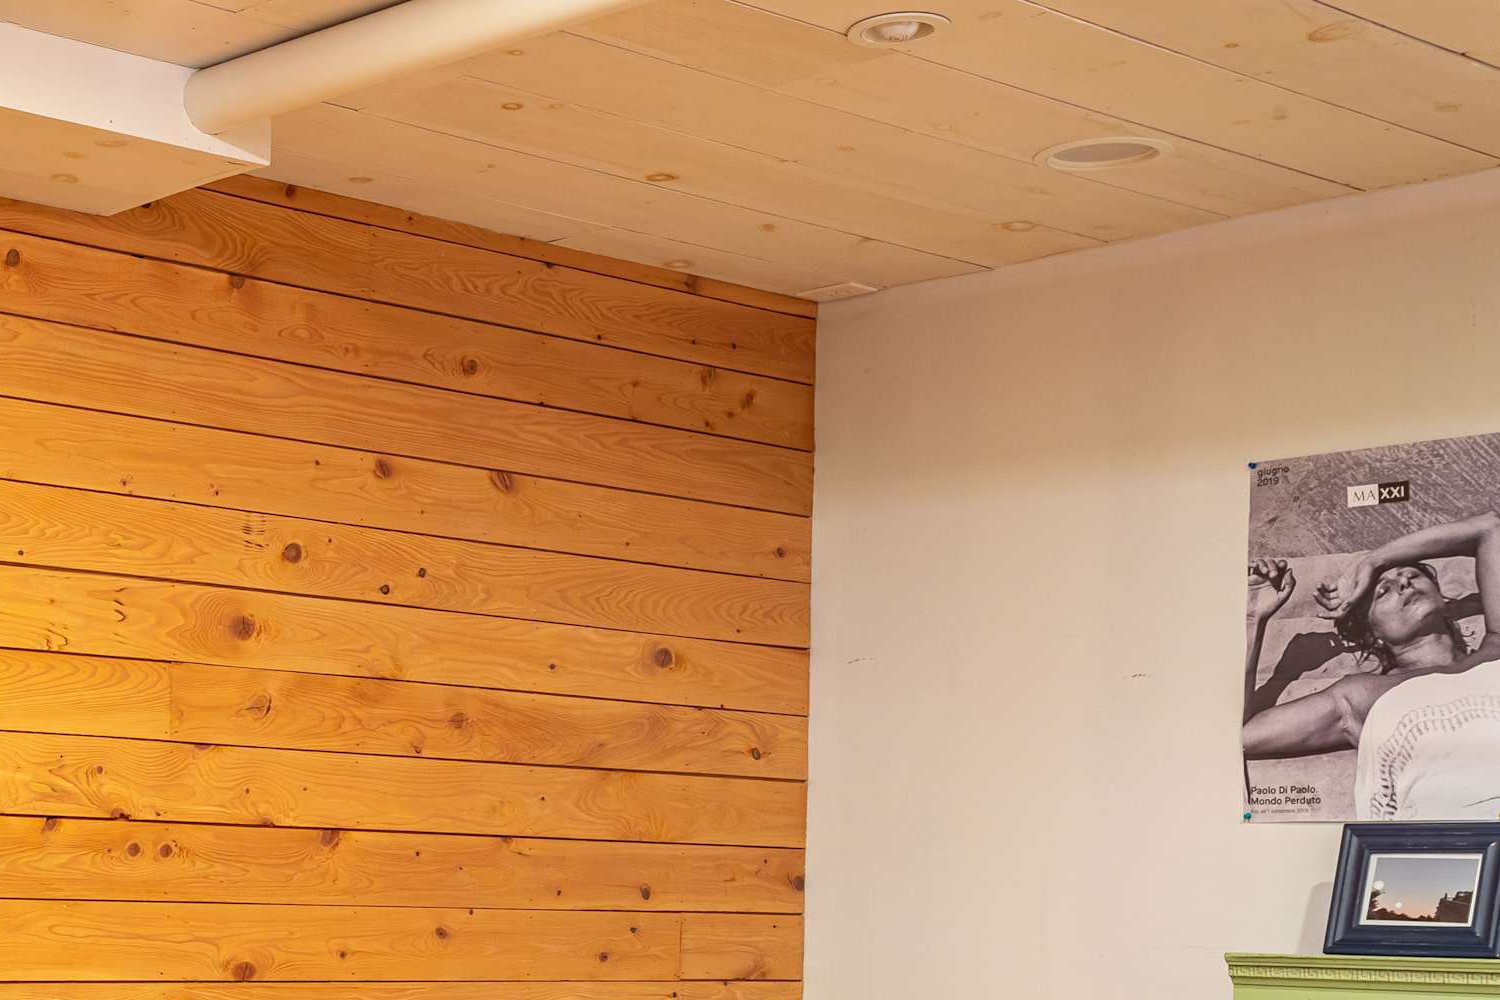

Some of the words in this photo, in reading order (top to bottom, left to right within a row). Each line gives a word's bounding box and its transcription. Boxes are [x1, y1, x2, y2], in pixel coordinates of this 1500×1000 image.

[1257, 465, 1289, 478] giugno
[1256, 476, 1279, 488] 2019
[1251, 786, 1276, 794] Paolo
[1279, 785, 1287, 793] Di
[1285, 796, 1321, 804] Perduto
